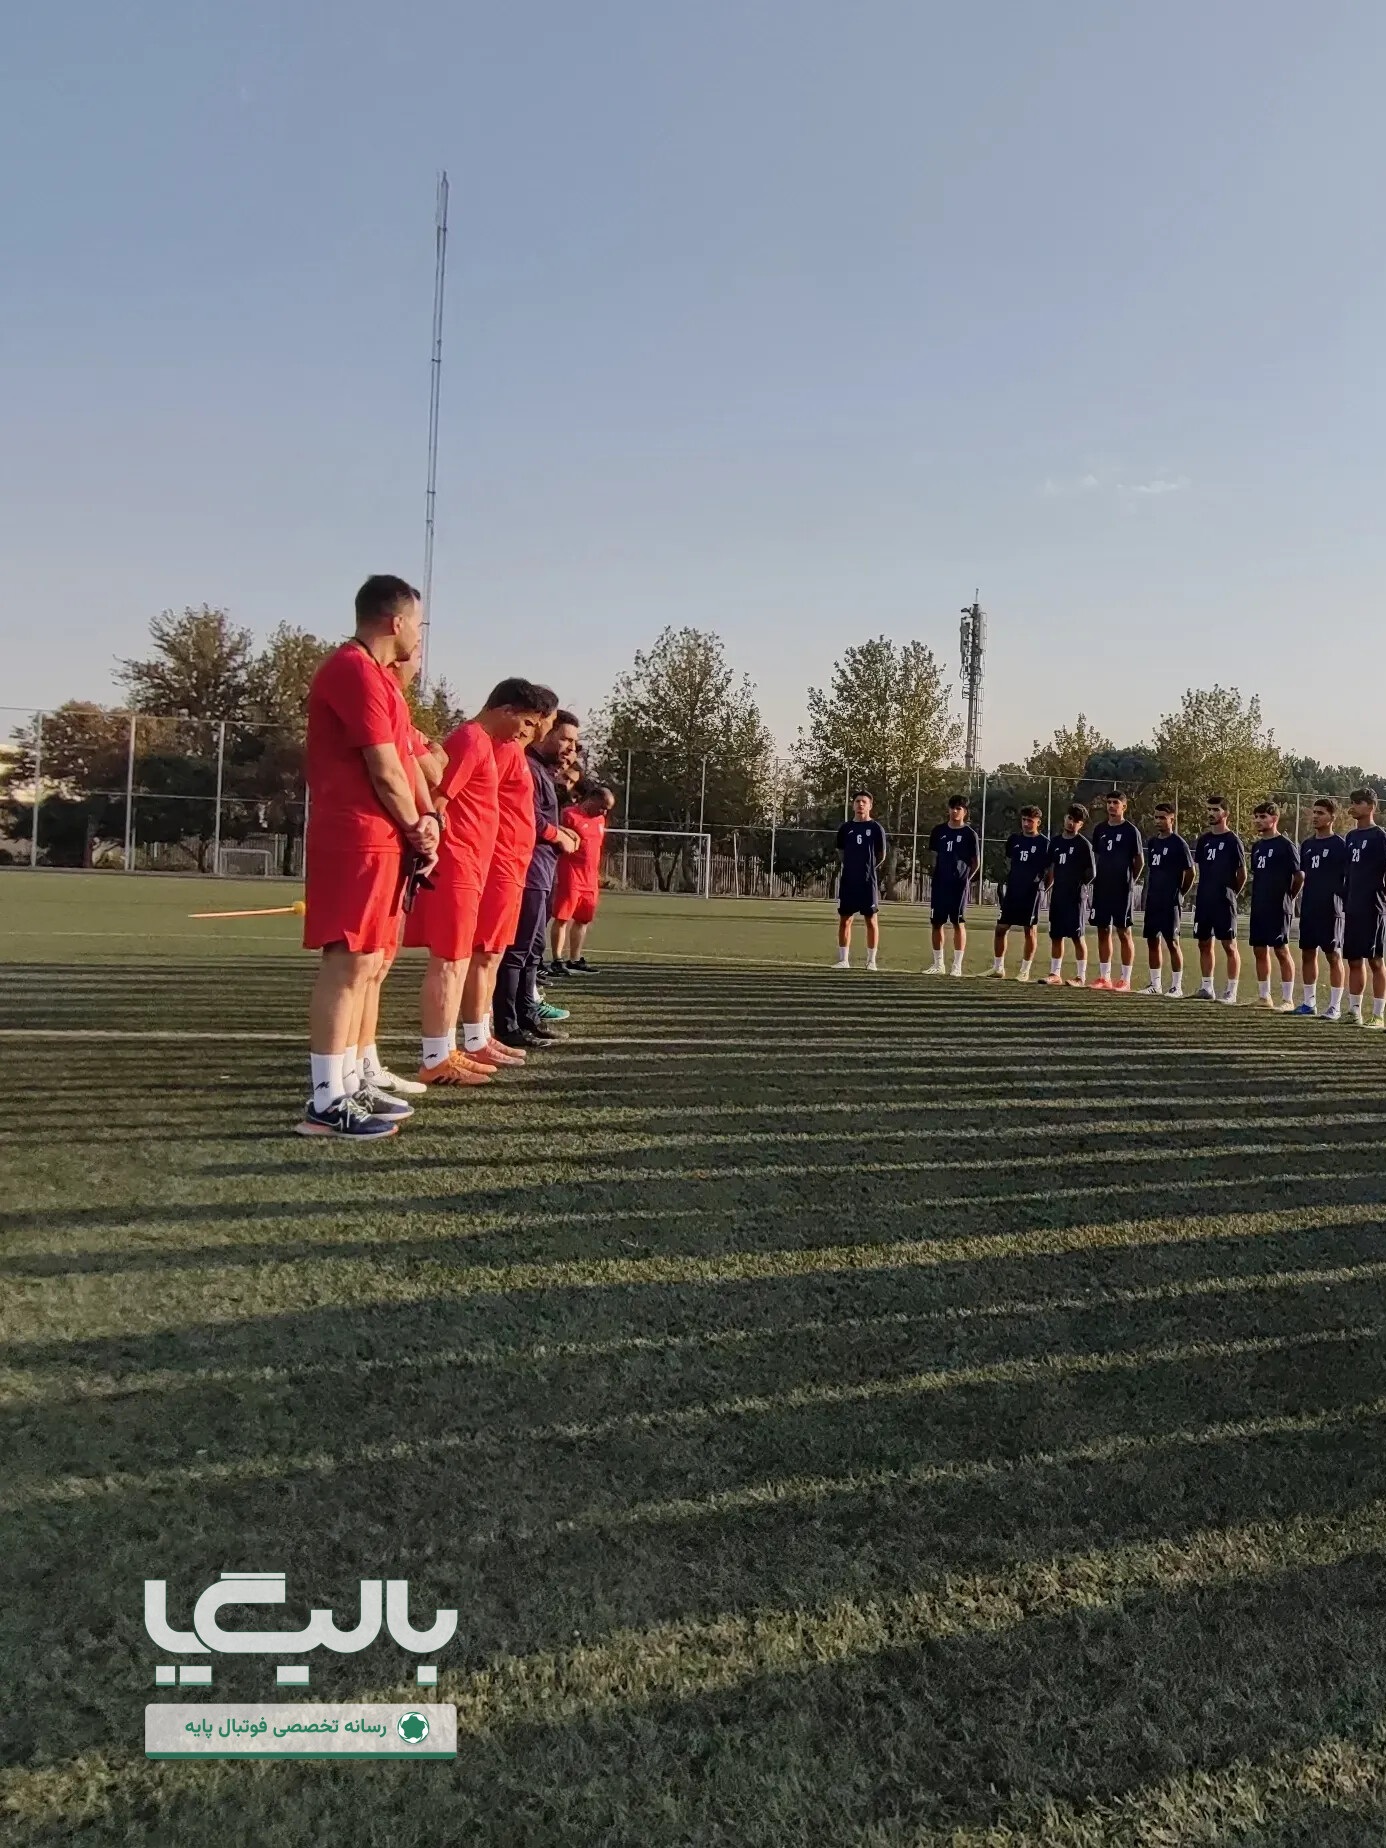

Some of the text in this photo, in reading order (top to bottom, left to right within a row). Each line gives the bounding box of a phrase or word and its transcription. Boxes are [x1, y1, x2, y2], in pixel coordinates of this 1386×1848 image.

[857, 834, 863, 845] 6
[1107, 840, 1113, 851] 3
[1020, 850, 1029, 862] 15
[1352, 848, 1360, 862] 23
[1257, 856, 1266, 869] 25
[1311, 855, 1320, 868] 13
